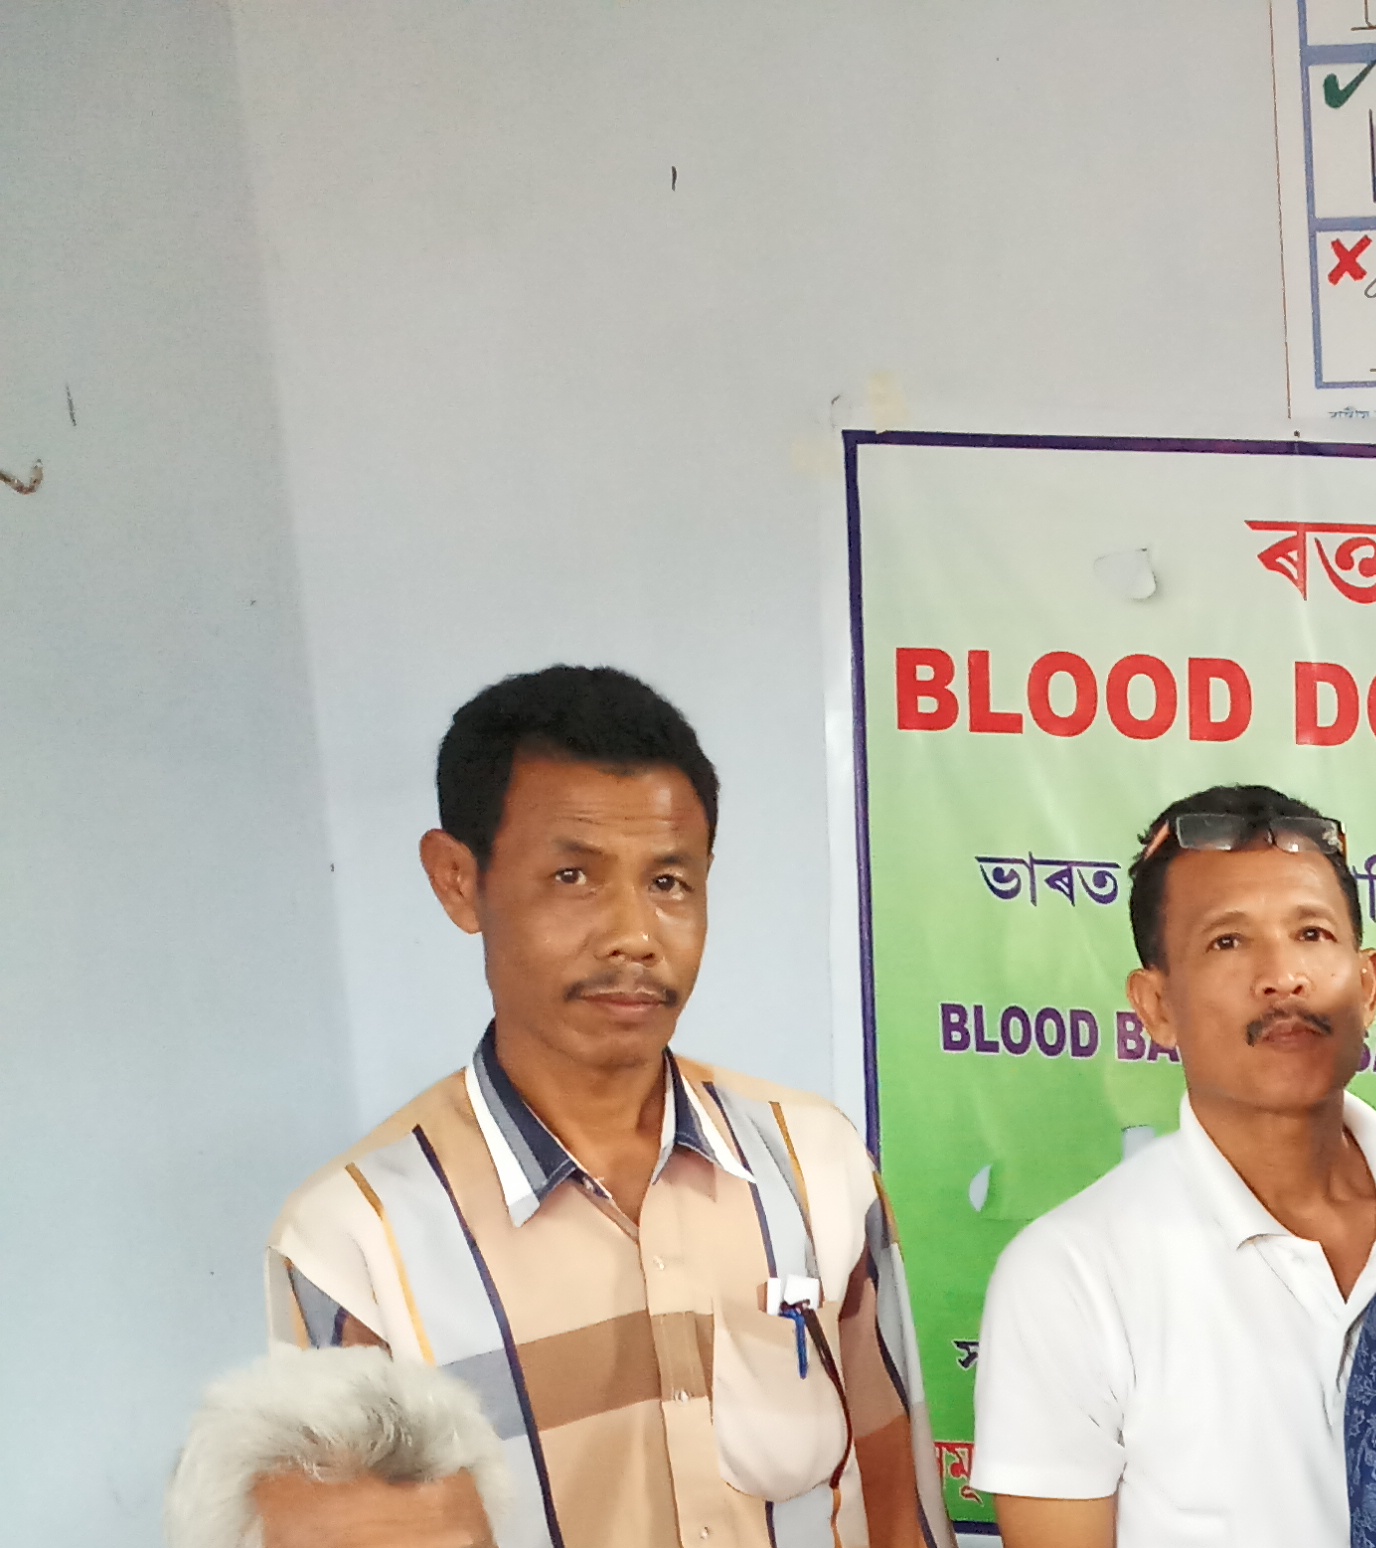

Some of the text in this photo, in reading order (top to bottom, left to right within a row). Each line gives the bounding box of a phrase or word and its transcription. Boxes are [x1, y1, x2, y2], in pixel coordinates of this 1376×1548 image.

[895, 647, 1253, 744] BLOOD
[974, 851, 1122, 908] ভাৰত
[940, 1003, 1099, 1058] BLOOD
